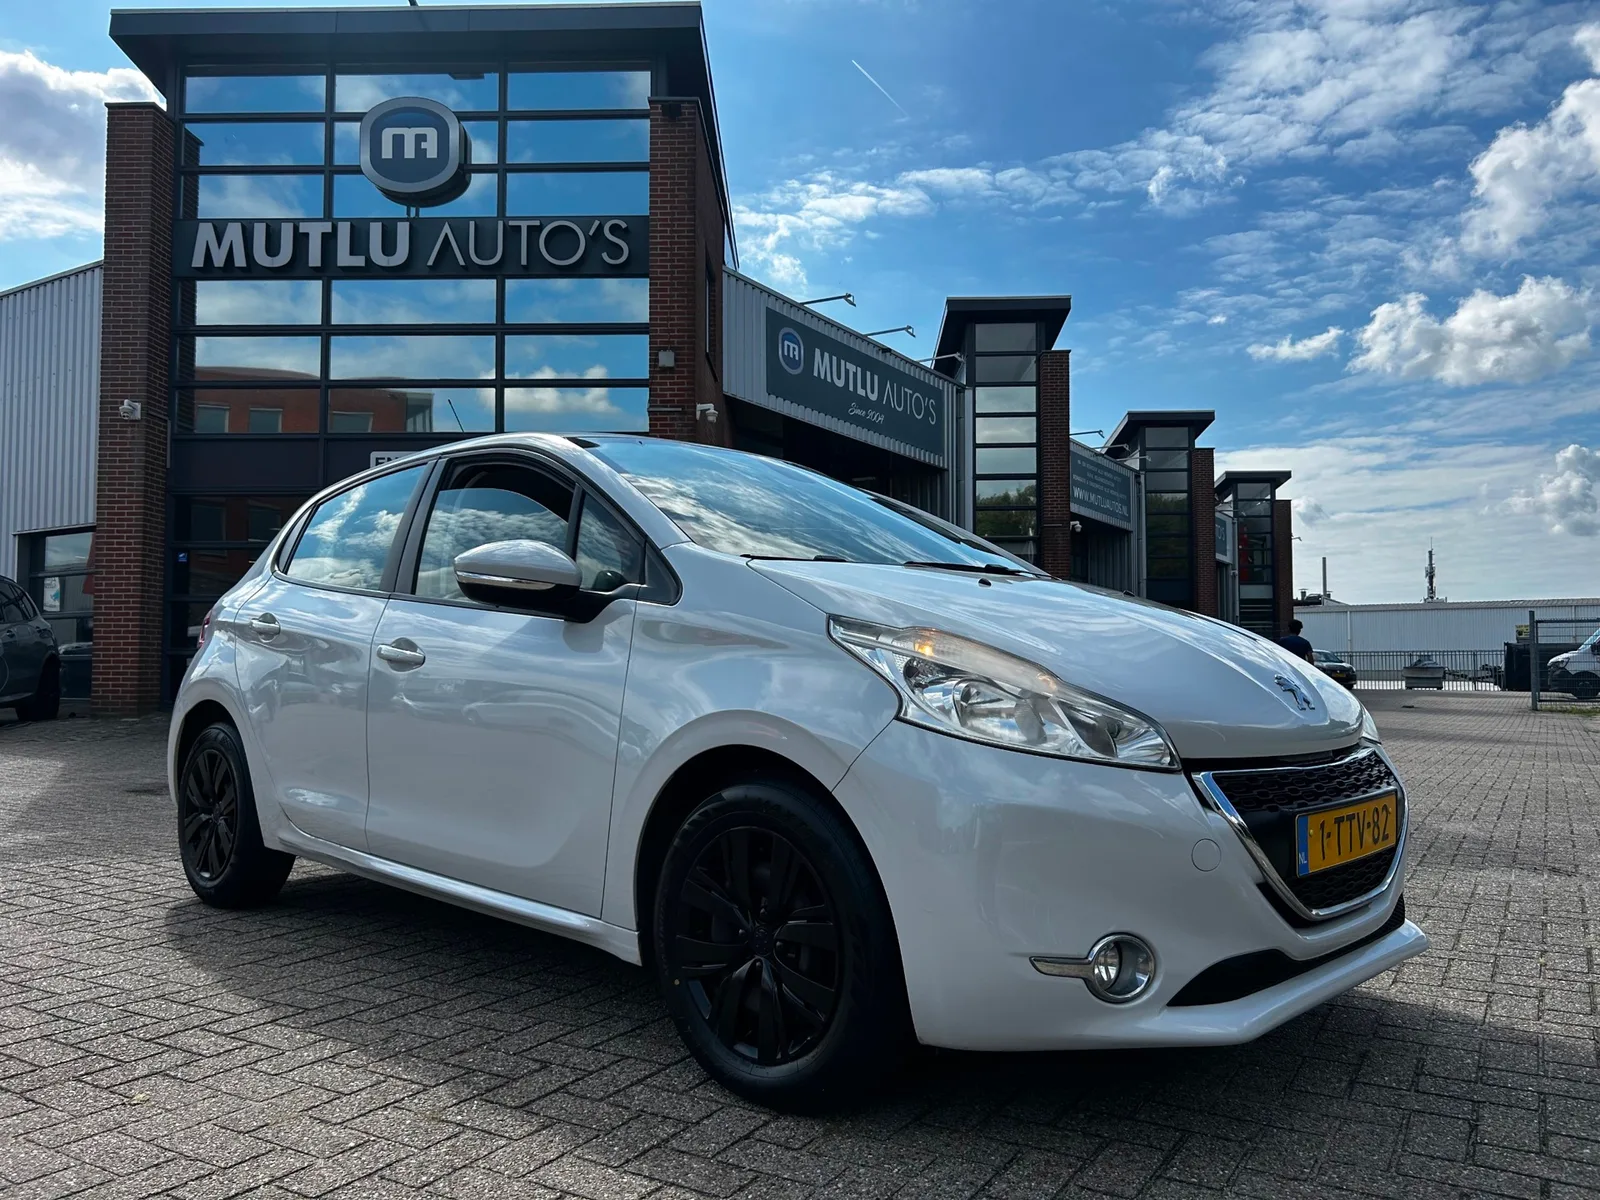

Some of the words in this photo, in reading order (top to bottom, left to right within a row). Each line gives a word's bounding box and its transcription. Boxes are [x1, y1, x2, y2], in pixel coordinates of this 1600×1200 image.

[191, 222, 410, 268] MUTLU
[427, 219, 630, 266] AUTO'S
[813, 348, 879, 401] MUTLU
[883, 380, 937, 425] AUTO'S
[848, 402, 866, 418] Since
[1320, 804, 1390, 861] 1-TTV-82
[1298, 852, 1308, 865] NL
